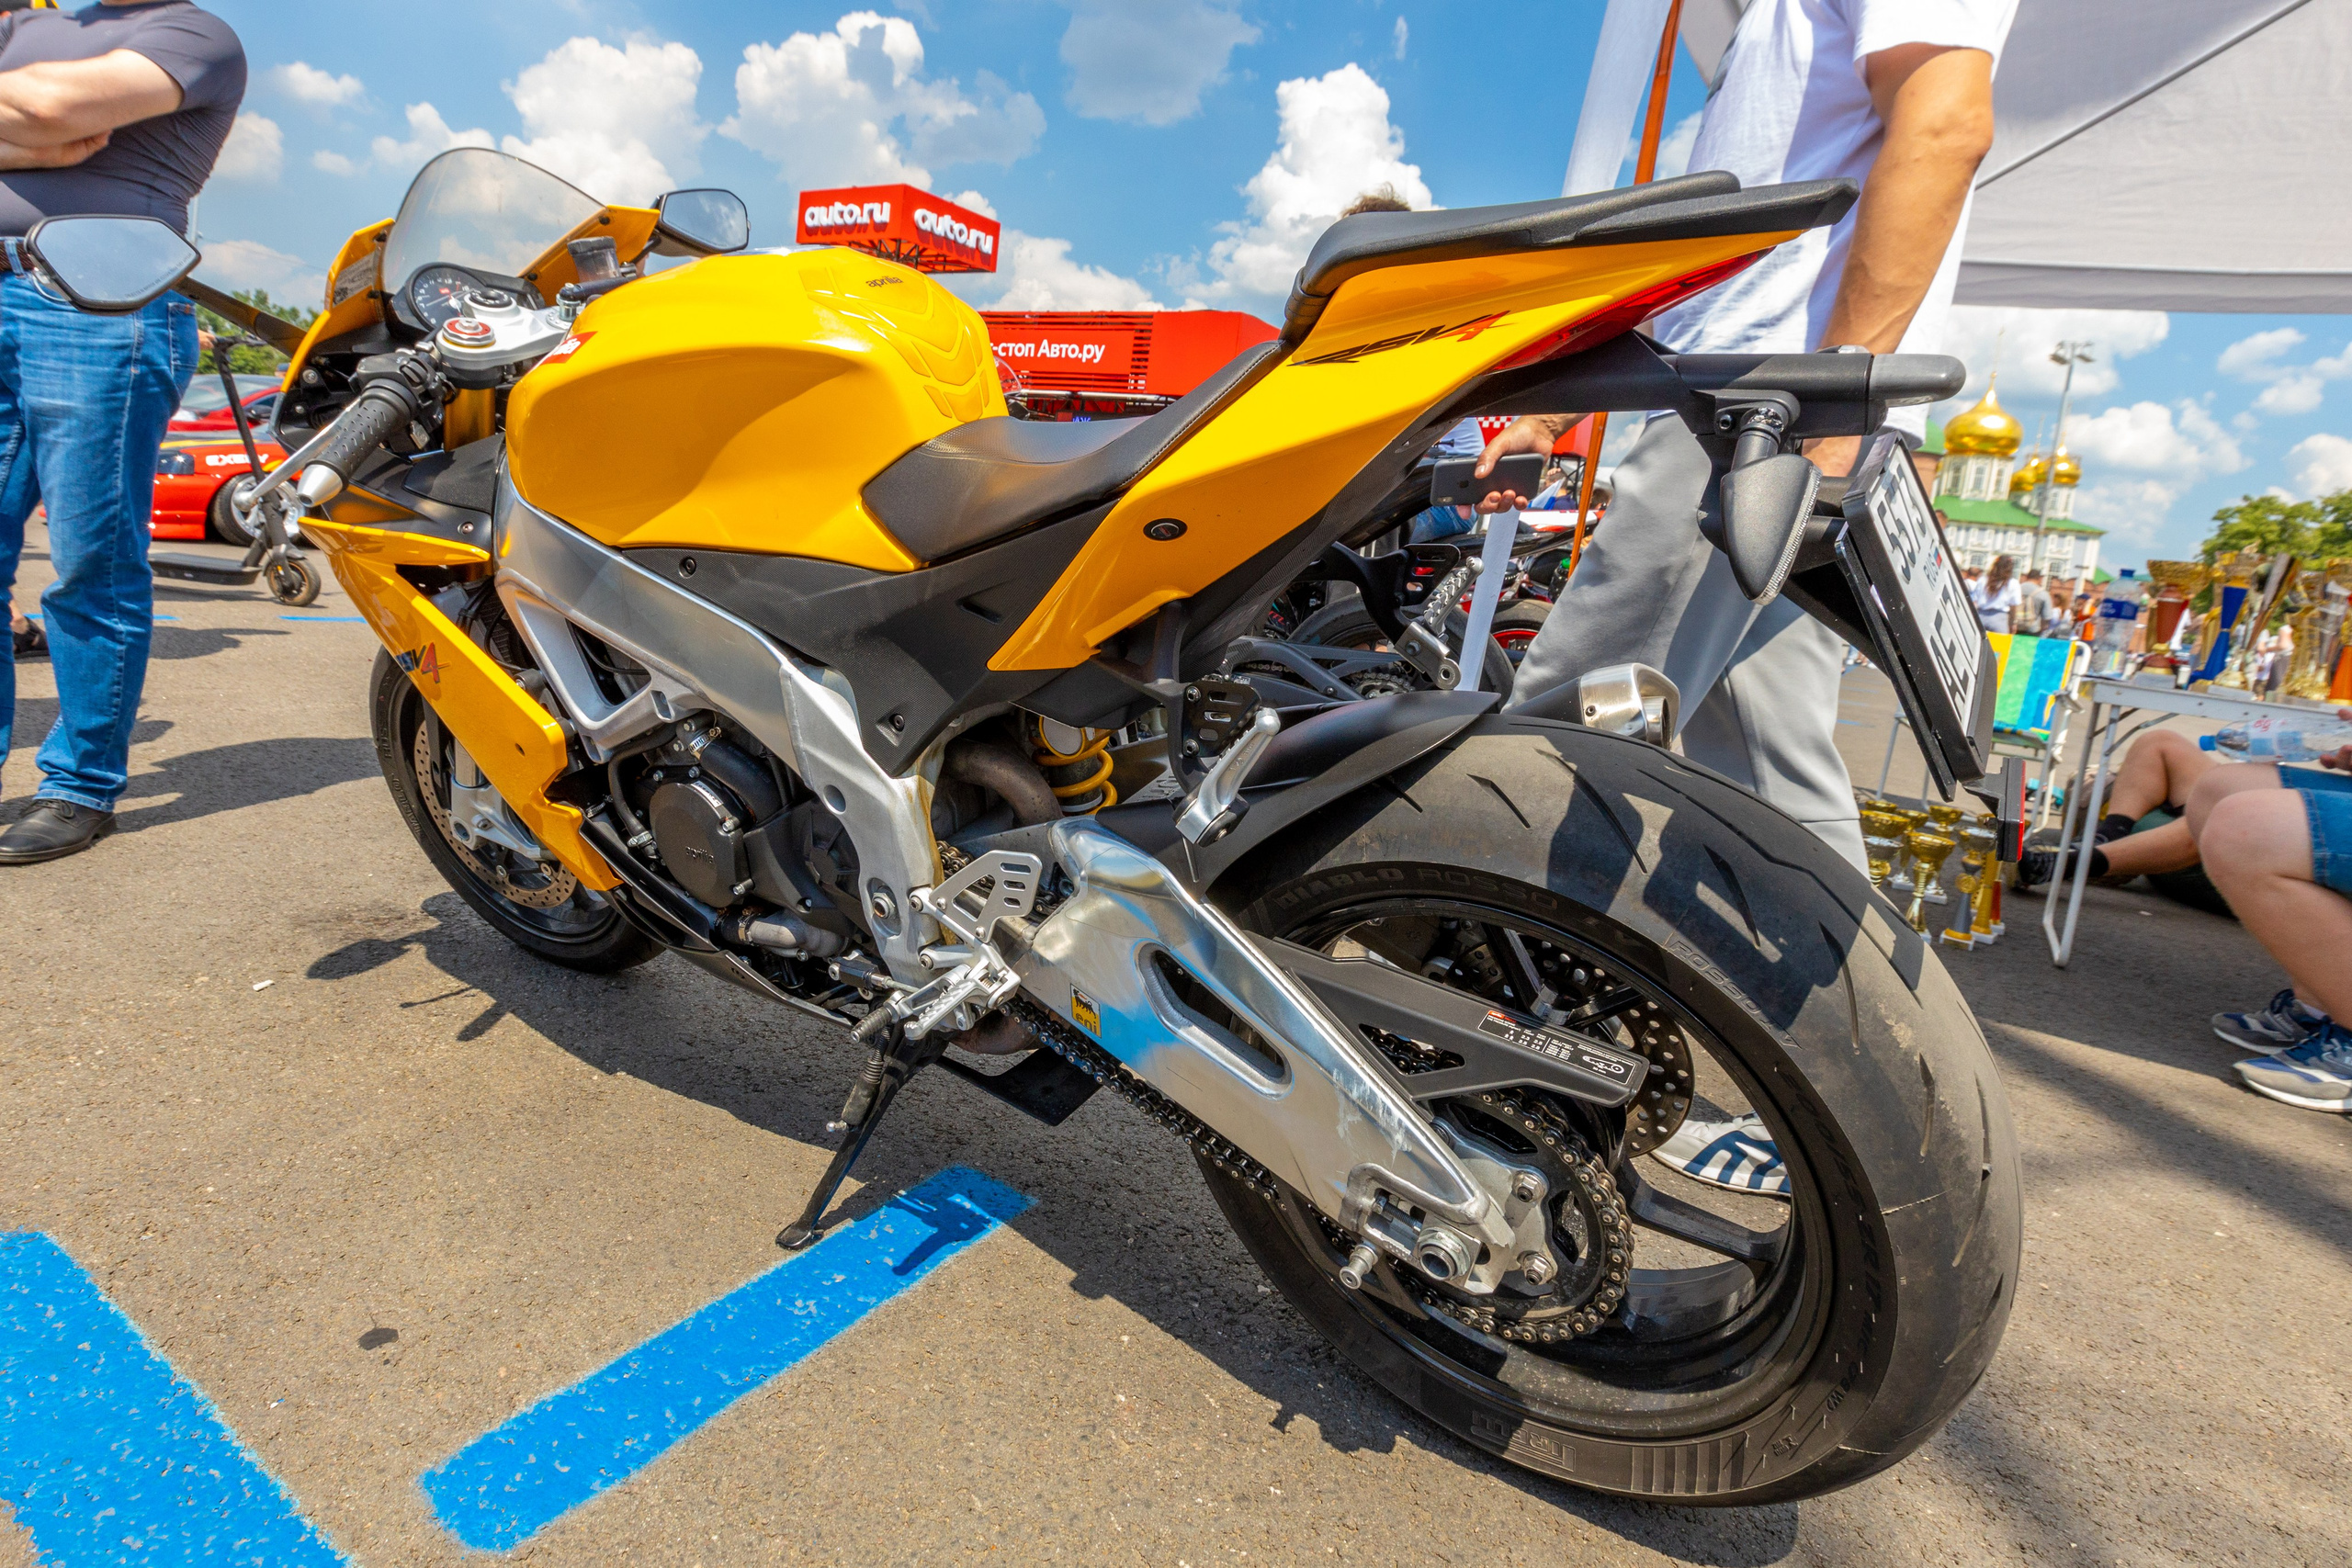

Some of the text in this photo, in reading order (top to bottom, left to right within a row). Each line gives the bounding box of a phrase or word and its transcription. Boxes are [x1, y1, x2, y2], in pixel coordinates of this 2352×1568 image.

[805, 201, 890, 228] auto.ru
[914, 208, 993, 254] auto.ru
[865, 276, 903, 288] aprilia
[1037, 338, 1105, 364] Авто.ру
